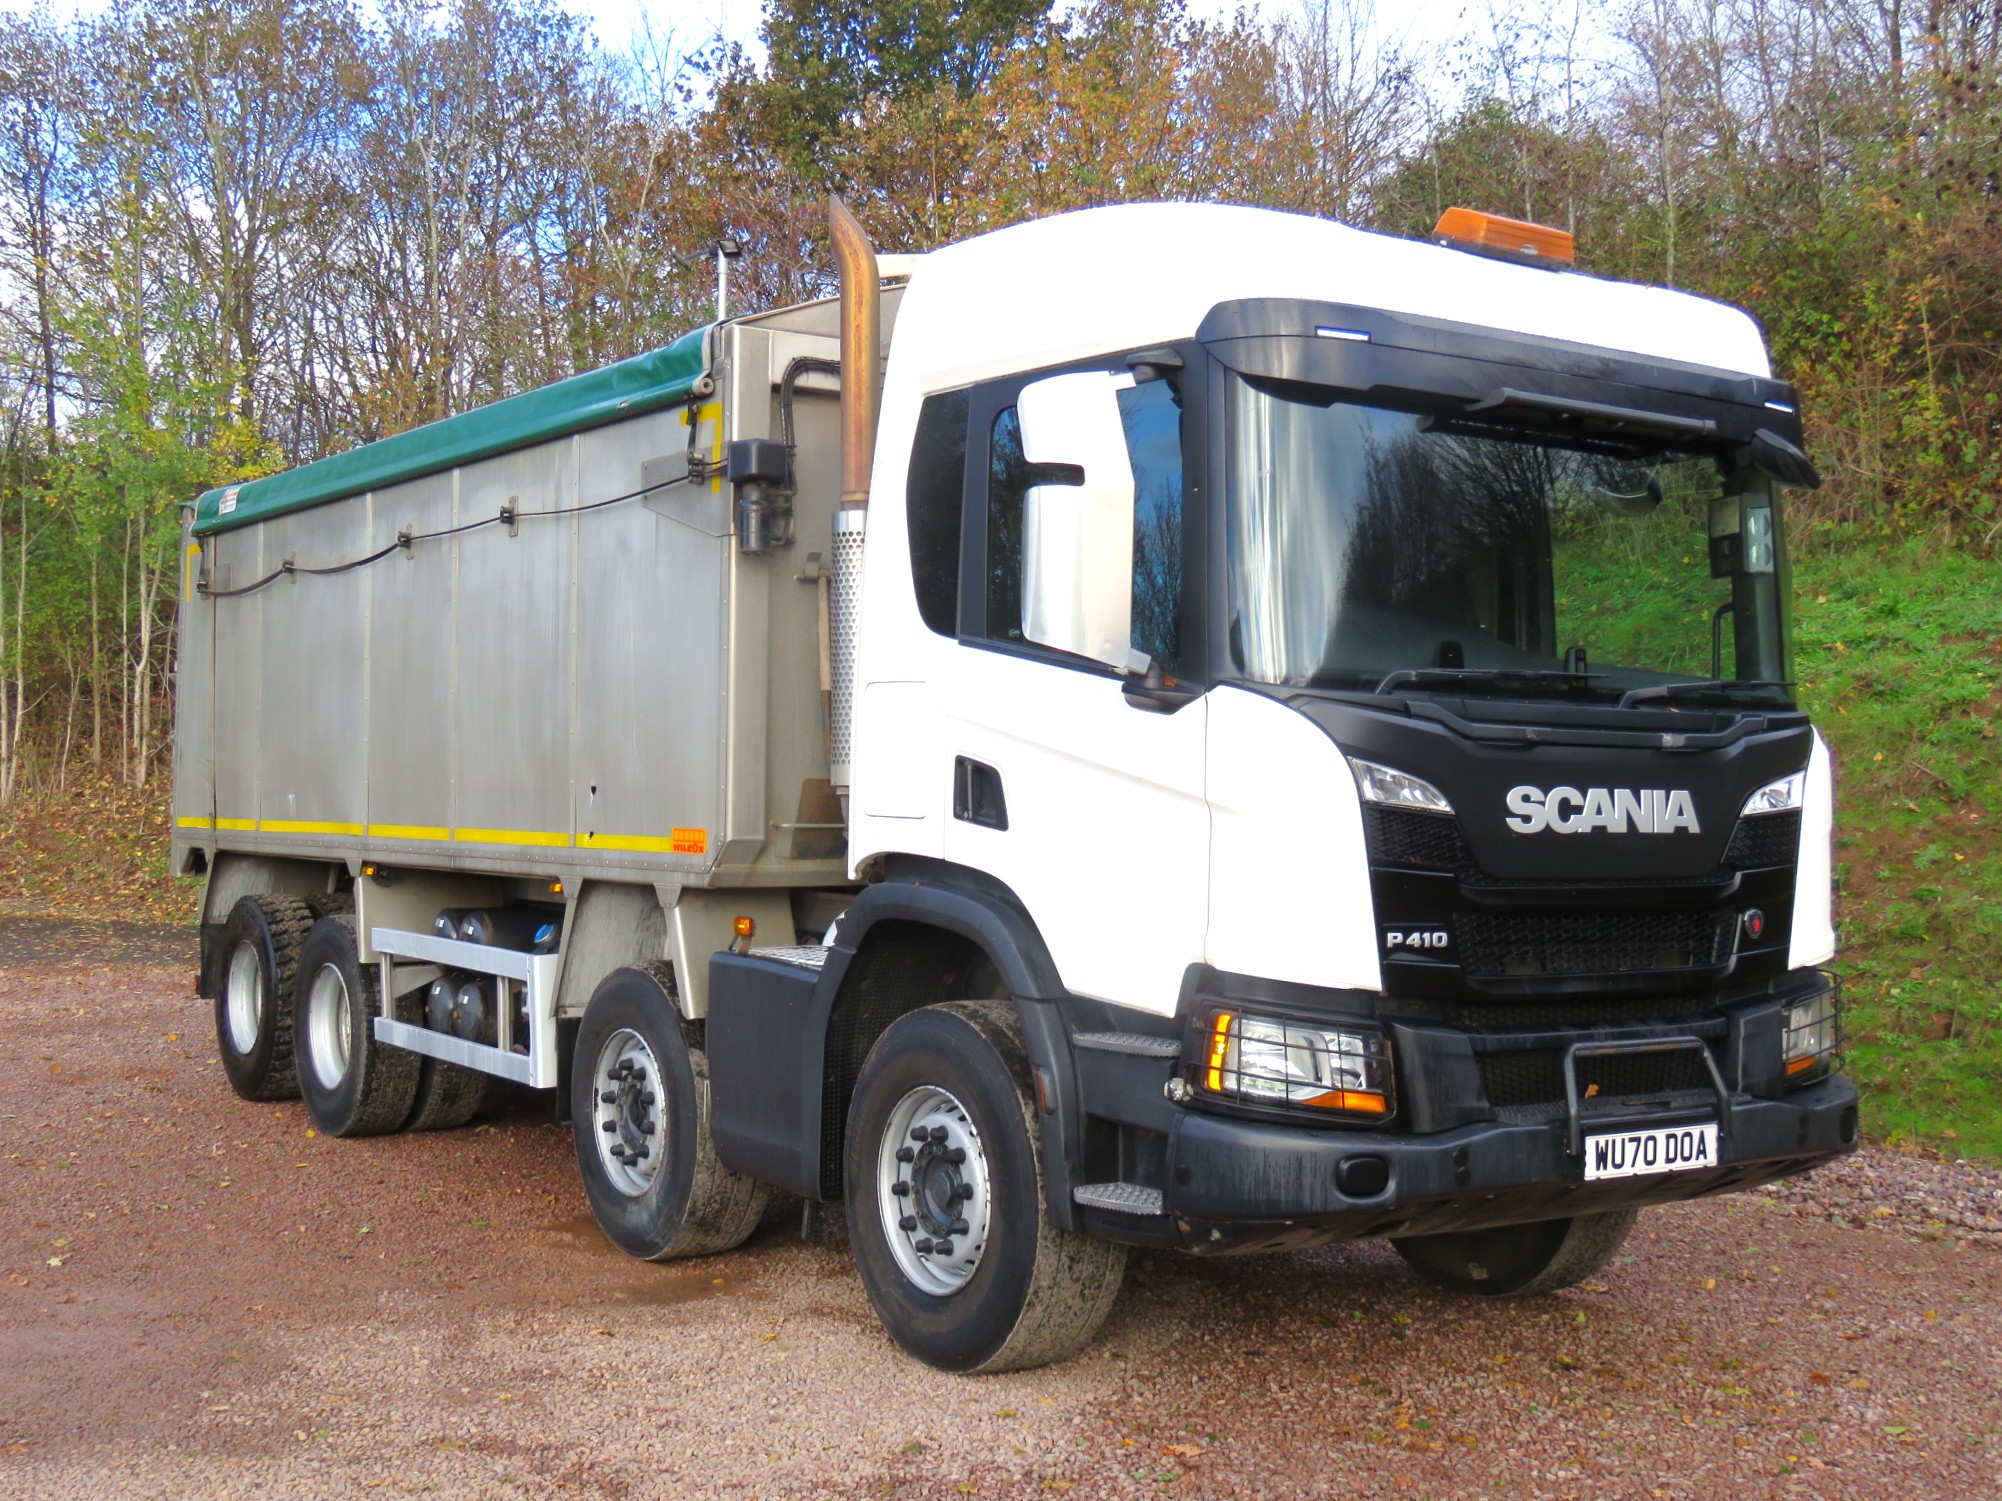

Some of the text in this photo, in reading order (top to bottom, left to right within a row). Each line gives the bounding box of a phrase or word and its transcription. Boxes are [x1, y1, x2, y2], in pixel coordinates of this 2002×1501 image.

[1505, 785, 1701, 834] SCANIA
[672, 842, 704, 854] WILCOX
[1595, 1129, 1708, 1172] WU70 DOA
